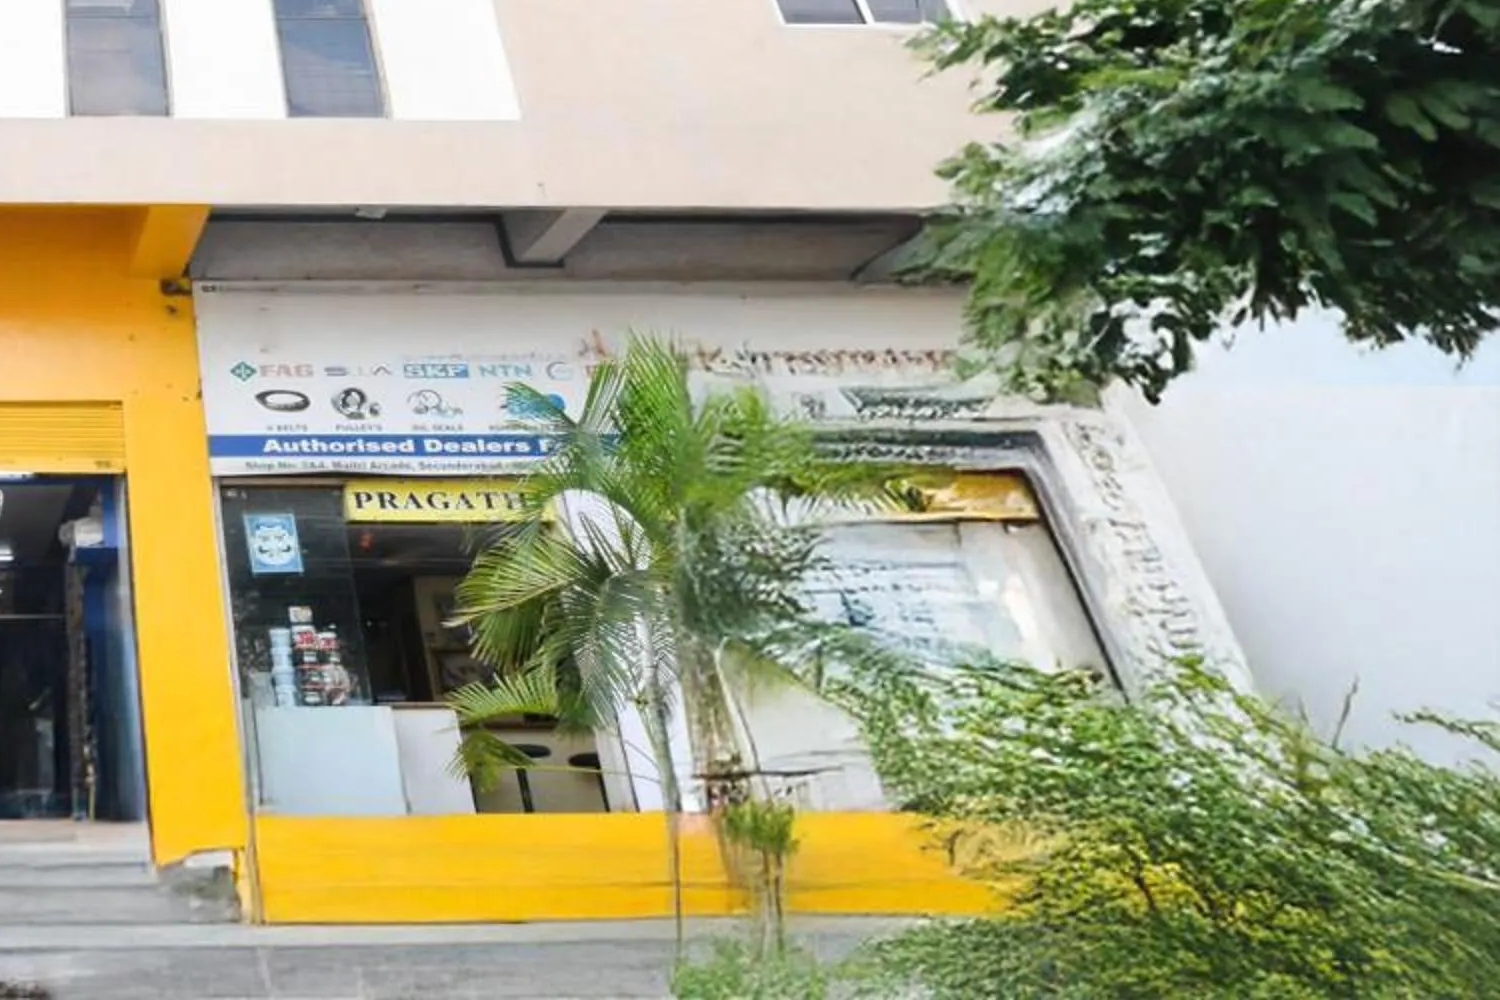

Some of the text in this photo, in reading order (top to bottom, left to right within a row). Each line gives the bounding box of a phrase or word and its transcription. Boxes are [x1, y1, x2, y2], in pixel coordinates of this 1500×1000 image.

[260, 364, 314, 377] FAG
[404, 364, 469, 378] SKF
[480, 364, 531, 377] NTN
[263, 438, 415, 453] Authorised
[424, 438, 530, 453] Dealers
[245, 460, 275, 471] Shop
[355, 491, 528, 510] PRAGATH
